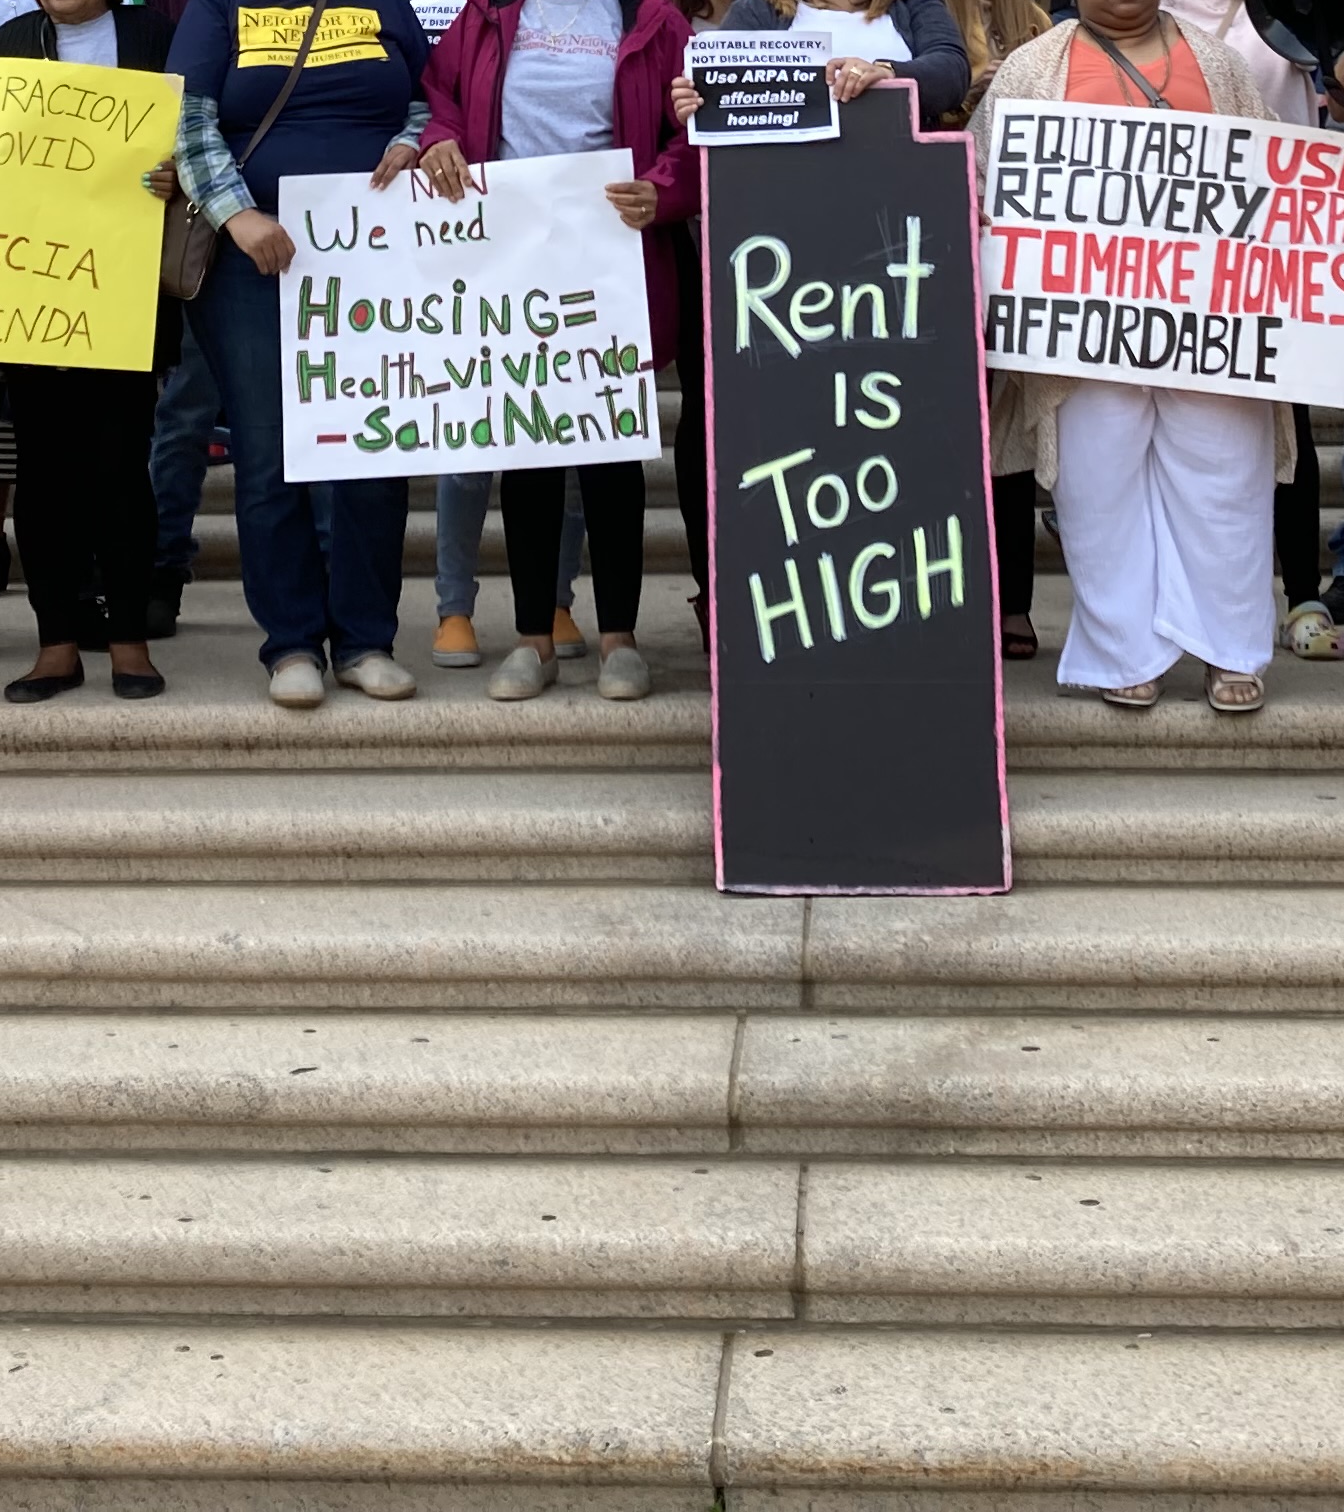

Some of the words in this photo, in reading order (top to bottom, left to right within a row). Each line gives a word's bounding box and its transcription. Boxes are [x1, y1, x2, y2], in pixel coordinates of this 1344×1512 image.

[348, 15, 372, 26] TO
[691, 41, 756, 50] EQUITABLE
[759, 41, 826, 51] RECOVERY,
[692, 55, 716, 64] NOT
[705, 71, 738, 84] Use
[742, 70, 789, 84] ARPA
[793, 69, 817, 82] for
[719, 90, 806, 105] affordable
[727, 111, 799, 127] housing!
[999, 114, 1252, 183] EQUITABLE
[993, 167, 1269, 245] RECOVERY,
[305, 205, 389, 252] We
[415, 201, 490, 247] need
[731, 216, 935, 357] Rent
[987, 295, 1283, 383] AFFORDABLE
[749, 513, 965, 663] HIGH
